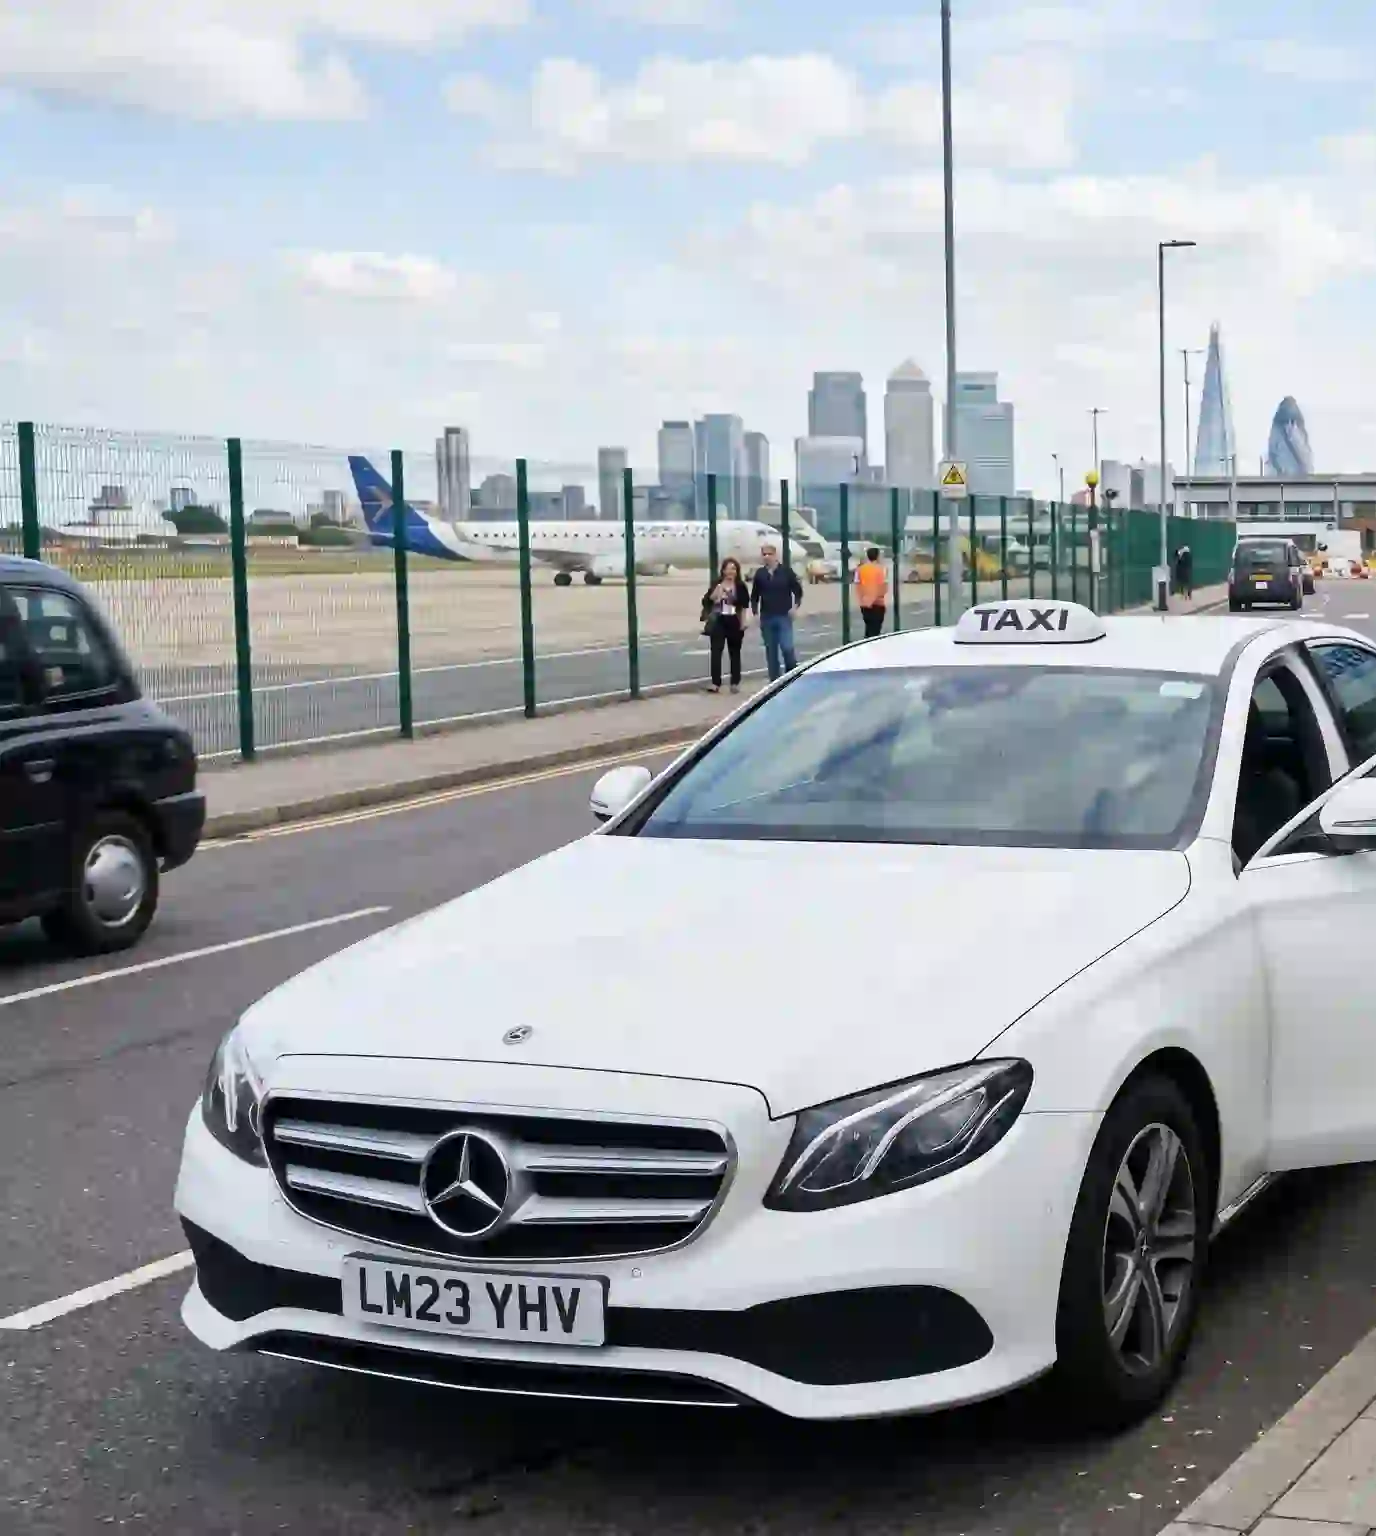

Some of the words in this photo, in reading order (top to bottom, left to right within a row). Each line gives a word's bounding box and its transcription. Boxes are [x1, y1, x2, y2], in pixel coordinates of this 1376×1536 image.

[974, 609, 1069, 631] TAXI
[359, 1267, 471, 1325] LM23
[485, 1282, 581, 1333] YHV
